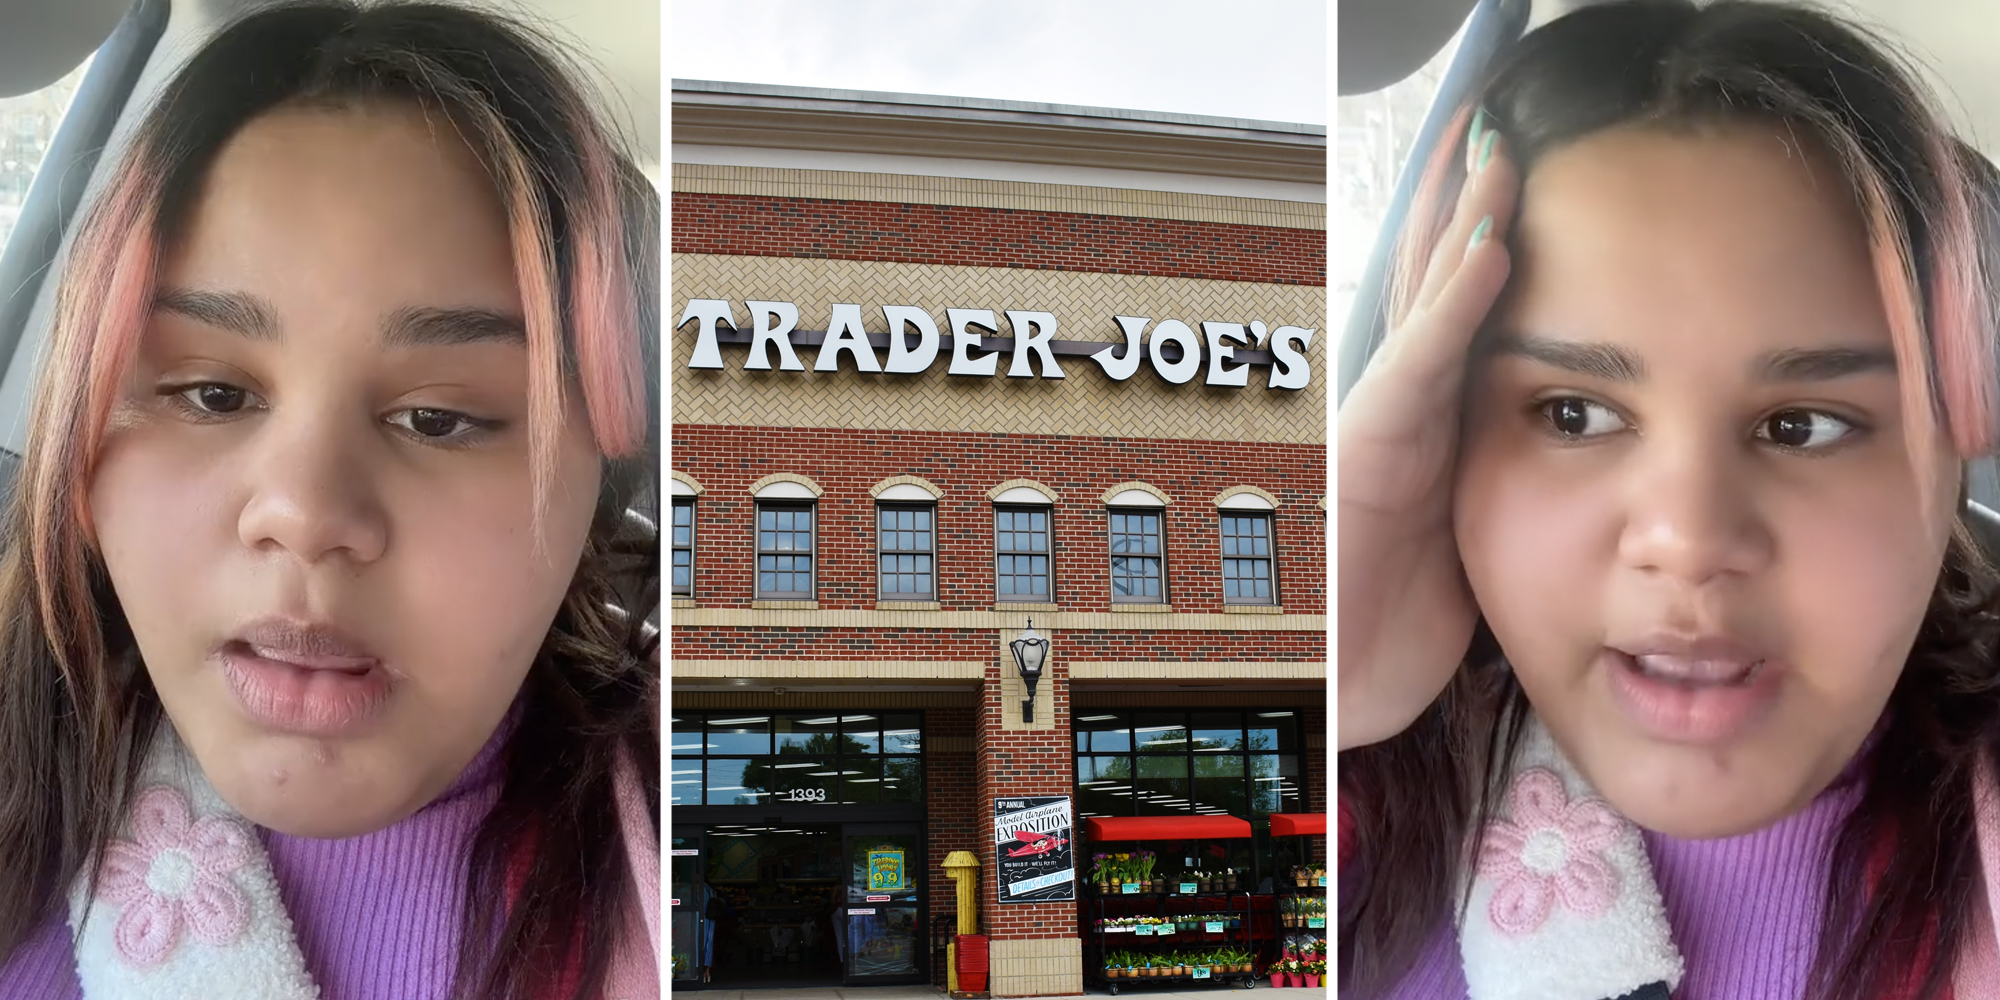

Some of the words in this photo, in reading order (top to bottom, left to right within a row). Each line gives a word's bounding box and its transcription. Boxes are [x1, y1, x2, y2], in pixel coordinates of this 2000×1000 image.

[676, 298, 1067, 380] TRADER
[1089, 314, 1317, 391] JOE'S
[788, 788, 826, 802] 1393
[1006, 801, 1025, 809] ANNUAL
[995, 812, 1024, 826] Model
[1025, 806, 1063, 820] Airplane
[996, 812, 1069, 842] EXPOSITION
[1012, 878, 1037, 894] DETAILS
